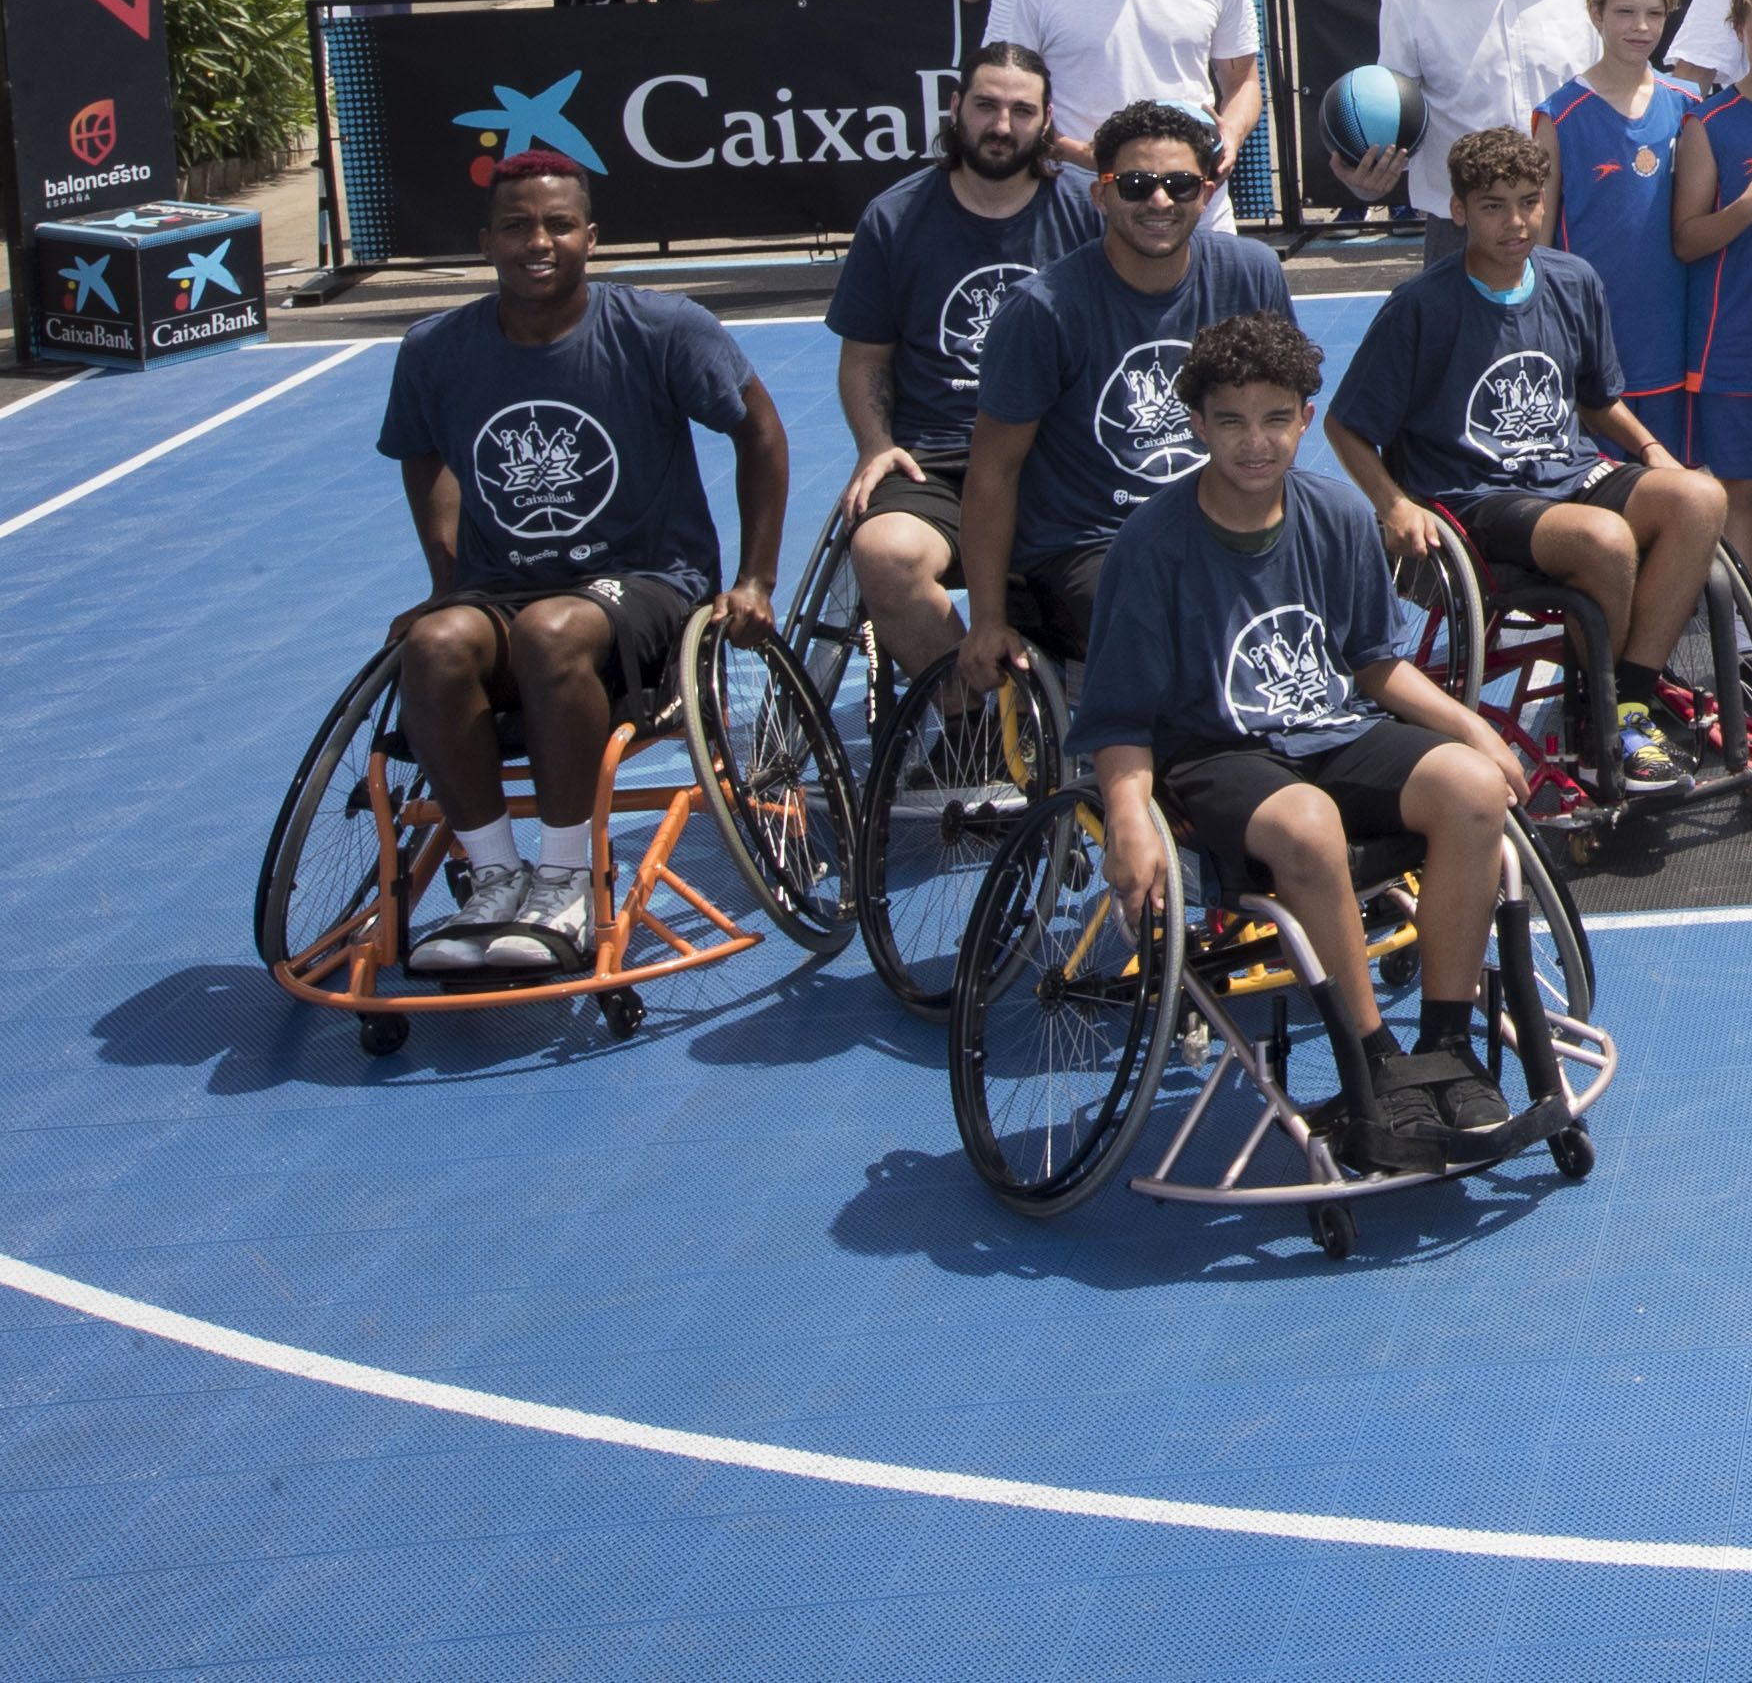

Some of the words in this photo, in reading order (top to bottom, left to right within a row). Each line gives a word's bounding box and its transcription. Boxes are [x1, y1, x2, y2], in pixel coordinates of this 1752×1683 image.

[623, 68, 962, 170] CaixaB
[44, 162, 152, 199] baloncesto
[46, 194, 92, 210] ESPAÑA
[45, 317, 135, 352] CaixaBank
[151, 305, 260, 349] CaixaBank
[1132, 427, 1194, 450] CaixaBank
[512, 489, 577, 510] CaixaBank
